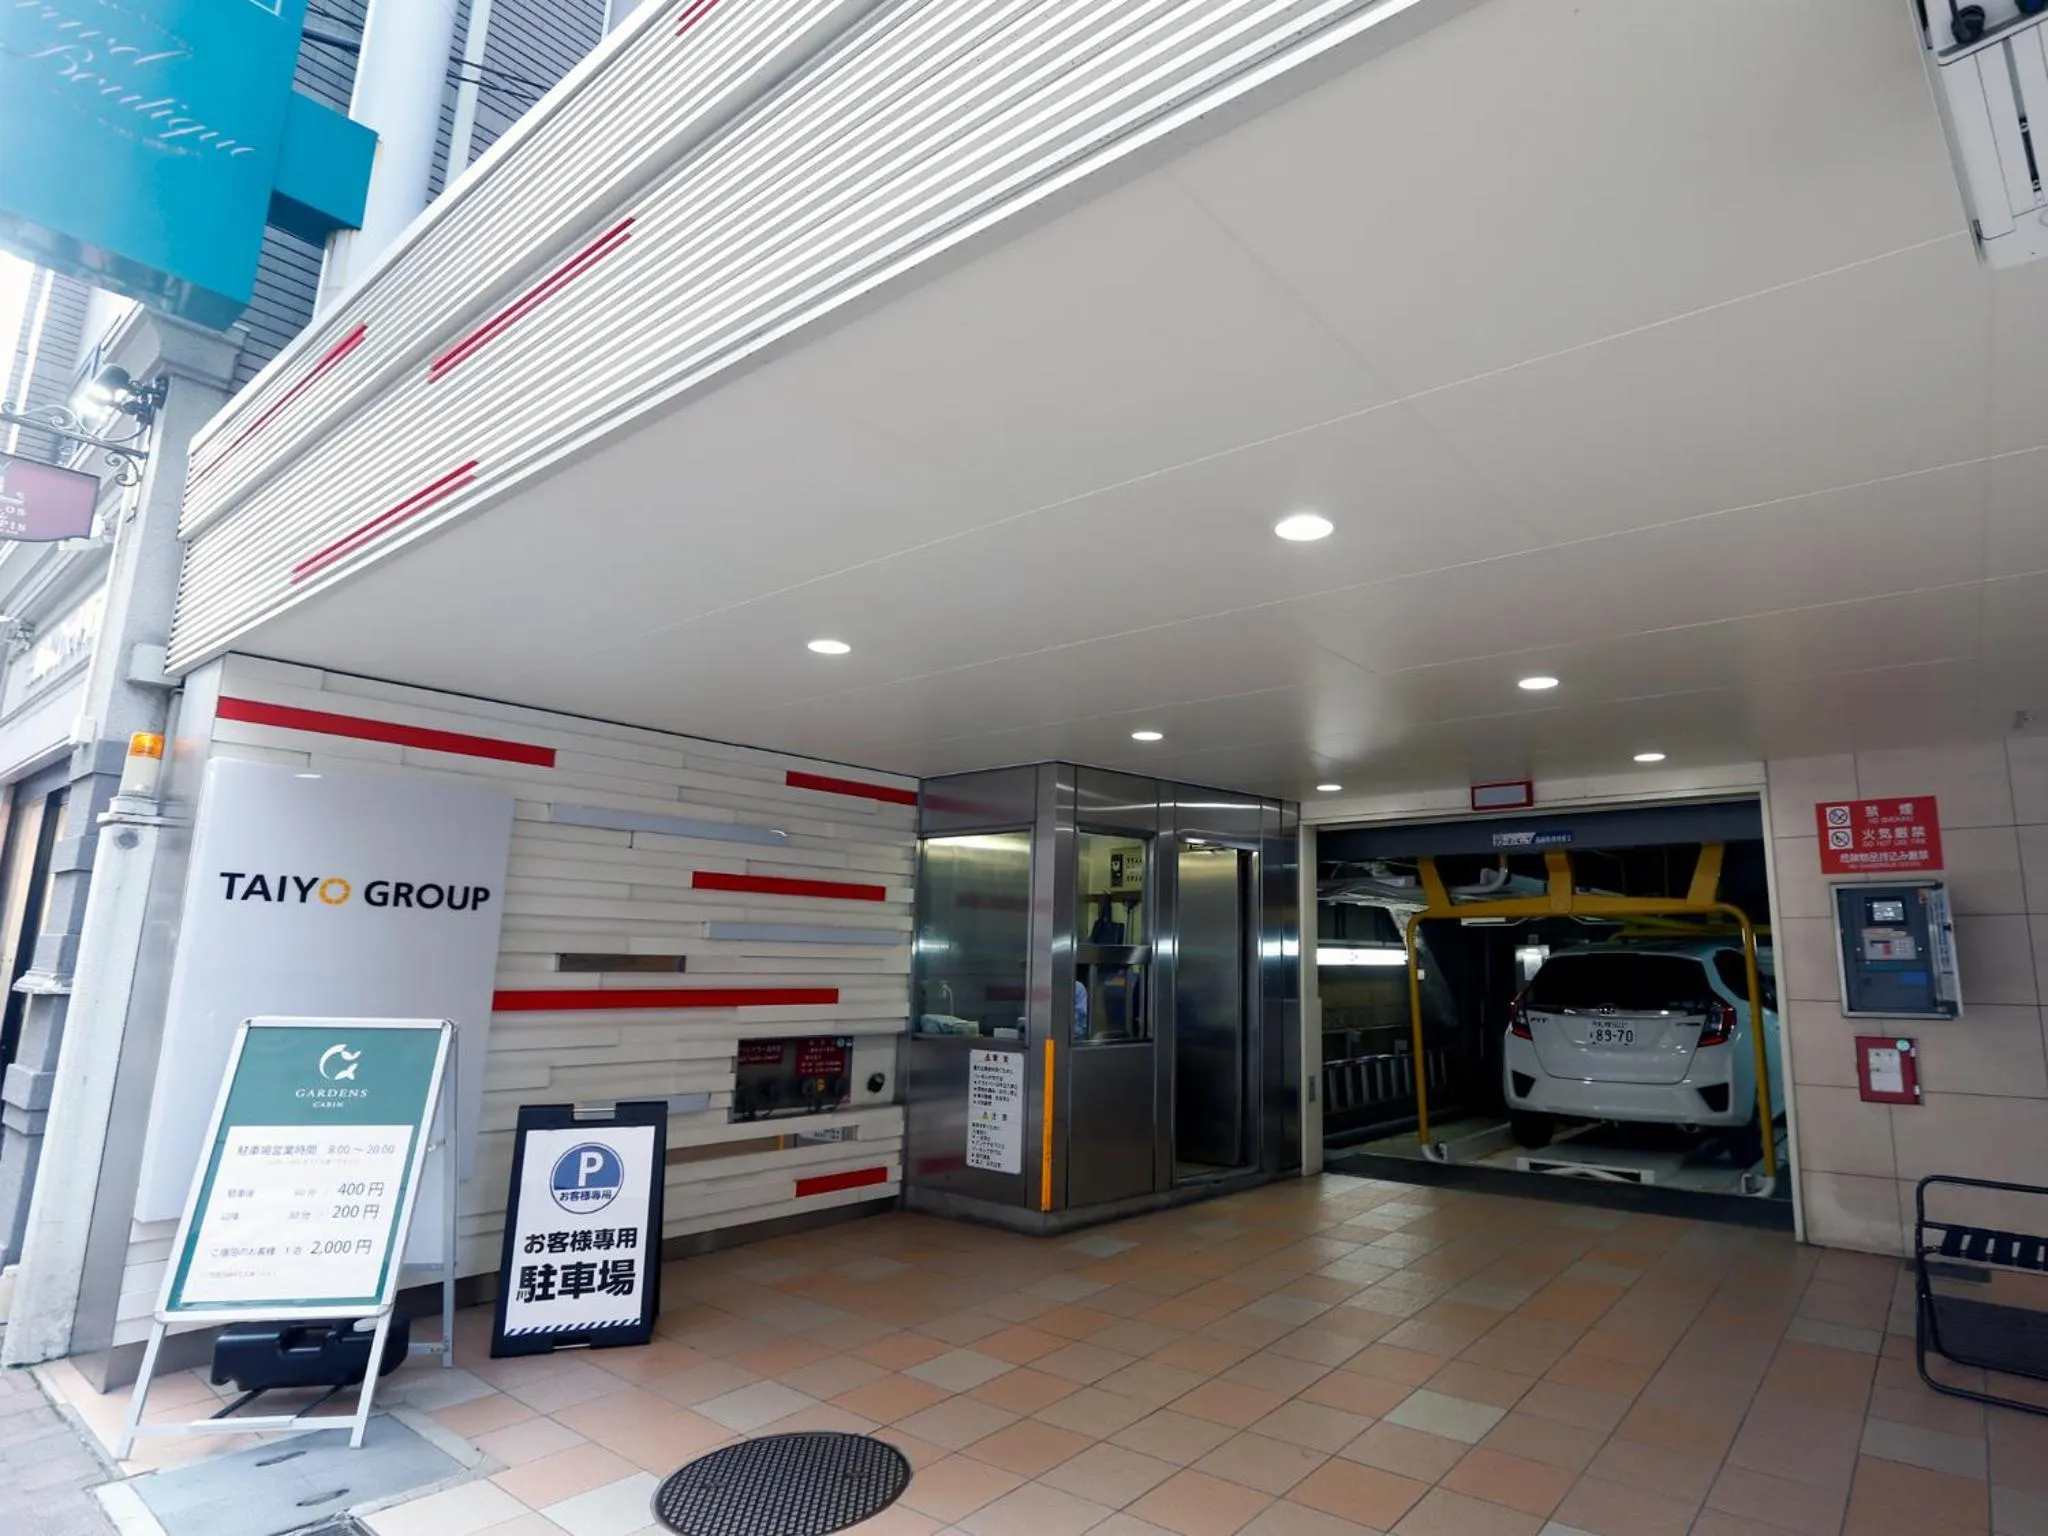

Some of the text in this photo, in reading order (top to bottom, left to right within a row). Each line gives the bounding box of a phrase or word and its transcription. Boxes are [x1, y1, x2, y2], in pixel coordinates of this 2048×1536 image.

[220, 872, 491, 911] TAIYO GROUP
[295, 1088, 369, 1098] GARDENS
[579, 1152, 604, 1187] P
[516, 1259, 637, 1304] 駐車場
